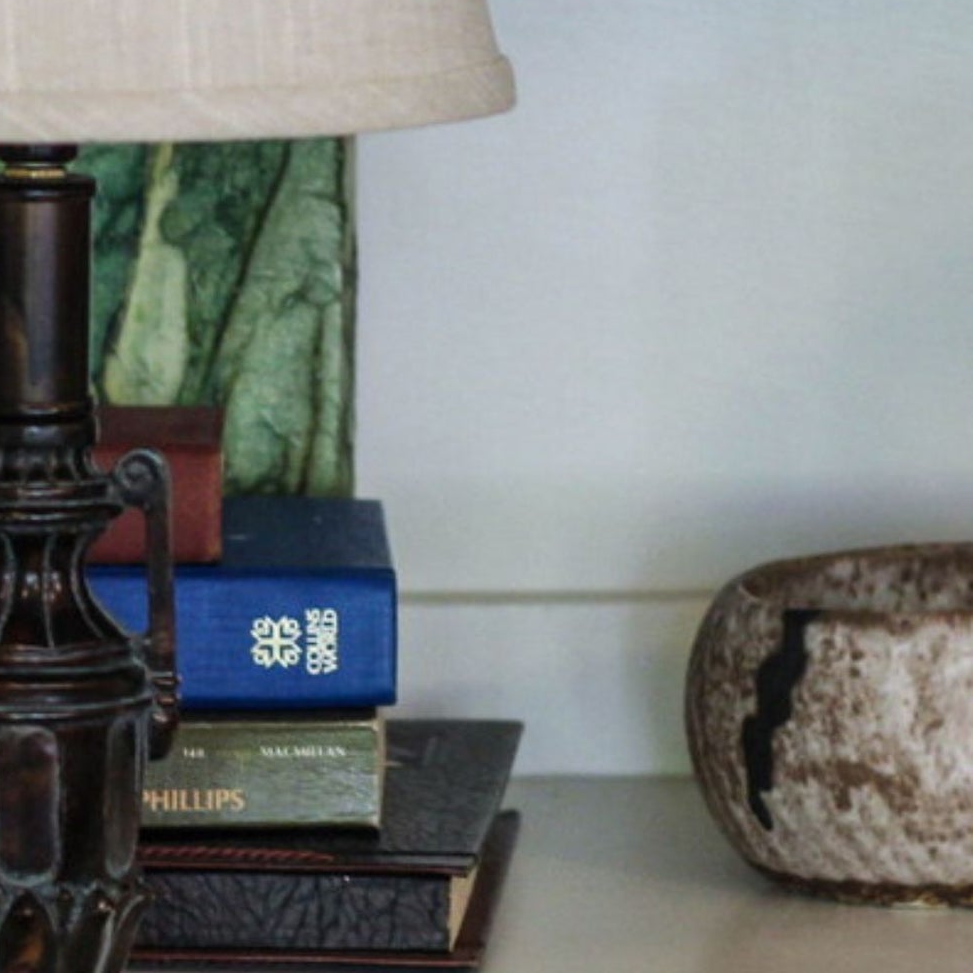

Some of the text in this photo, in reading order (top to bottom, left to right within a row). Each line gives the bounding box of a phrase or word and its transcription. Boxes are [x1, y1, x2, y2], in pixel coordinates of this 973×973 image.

[305, 608, 322, 675] COLLINS
[322, 608, 338, 674] WORLD
[259, 745, 347, 758] MACMILLAN
